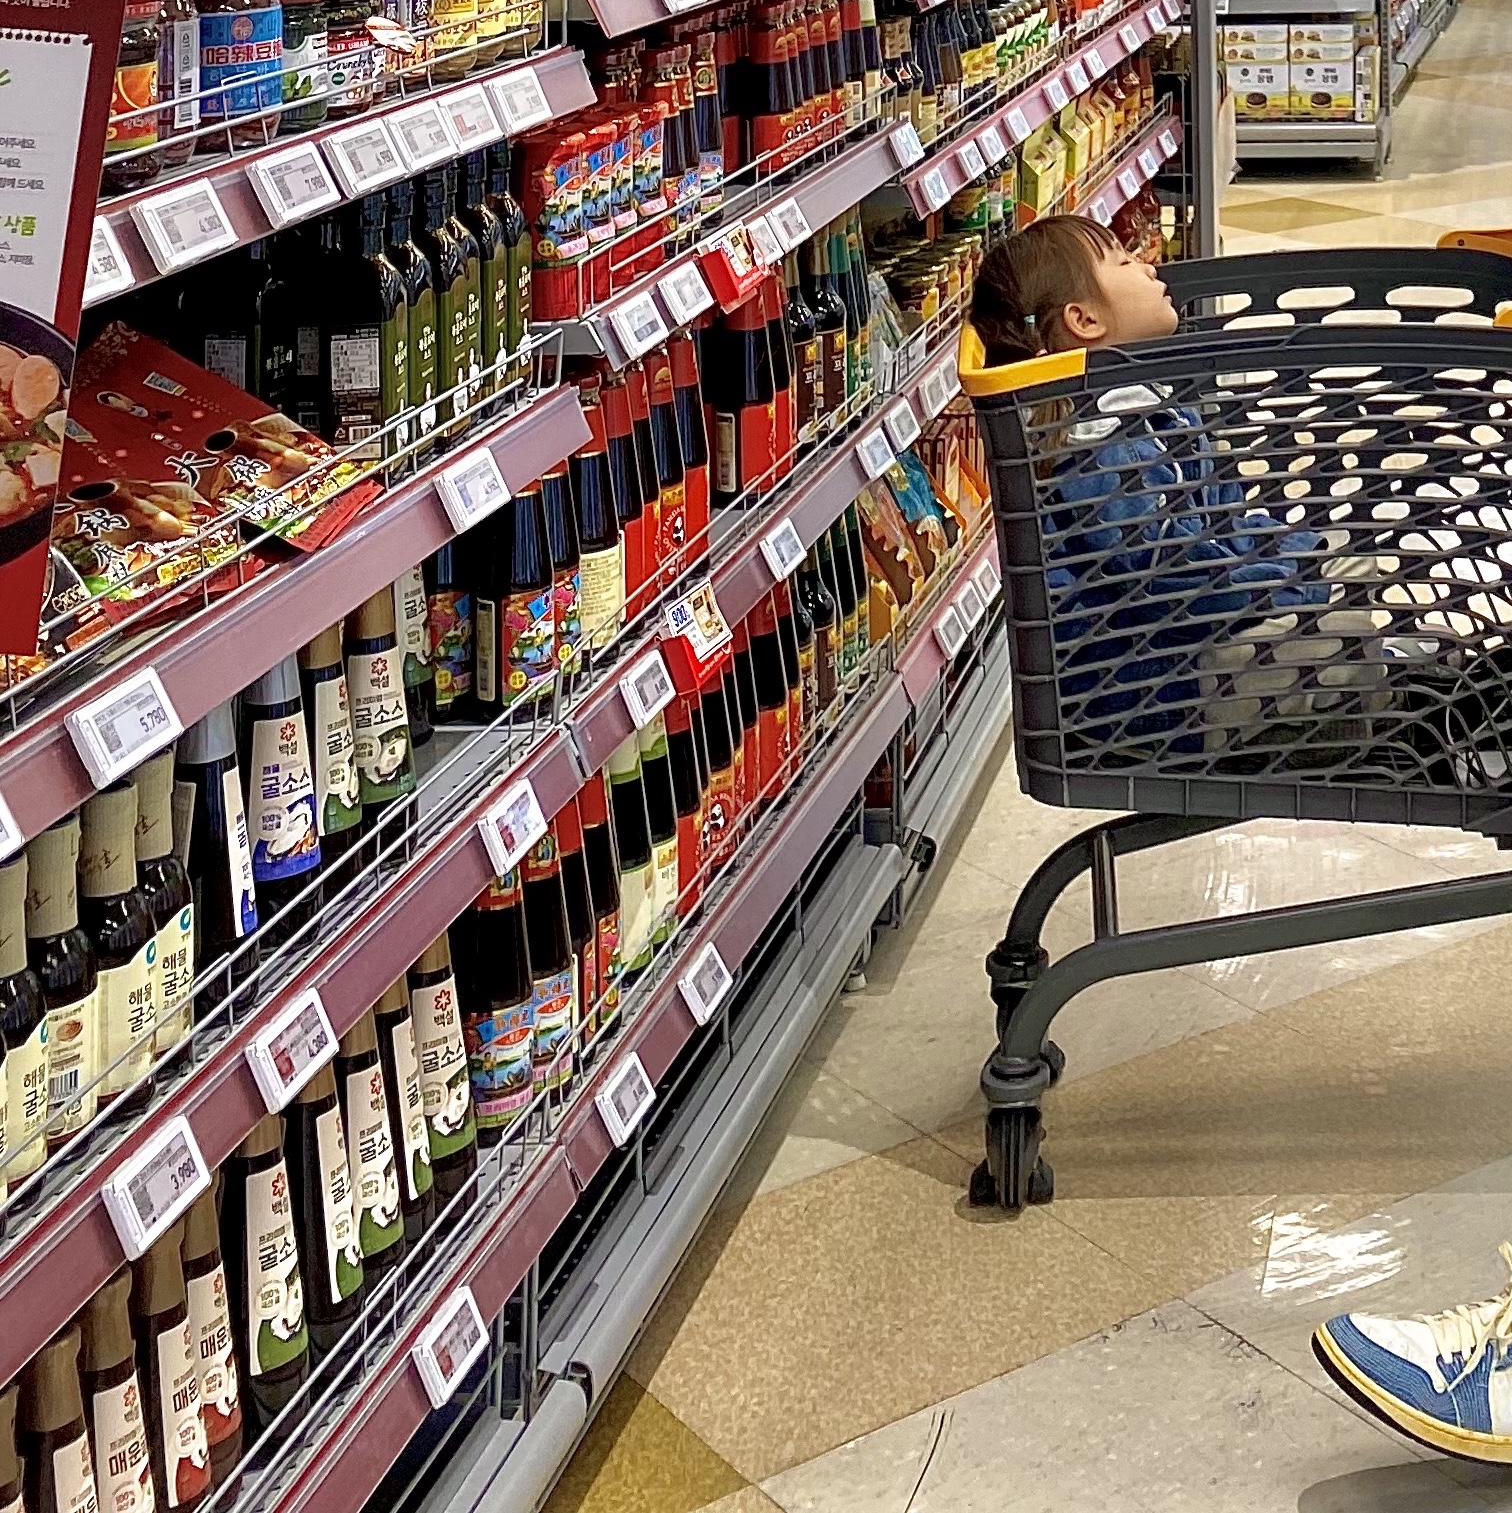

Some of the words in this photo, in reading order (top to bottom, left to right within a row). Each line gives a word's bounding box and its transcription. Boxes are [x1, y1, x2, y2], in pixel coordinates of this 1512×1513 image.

[369, 674, 390, 689] 백설
[354, 703, 405, 727] 굴소스
[277, 744, 299, 757] 백설
[162, 948, 188, 971] 해물
[128, 980, 153, 1006] 해물
[432, 1012, 456, 1028] 백설
[420, 1043, 468, 1073] 굴소스
[199, 1324, 233, 1360] 매운
[108, 1436, 148, 1477] 매운
